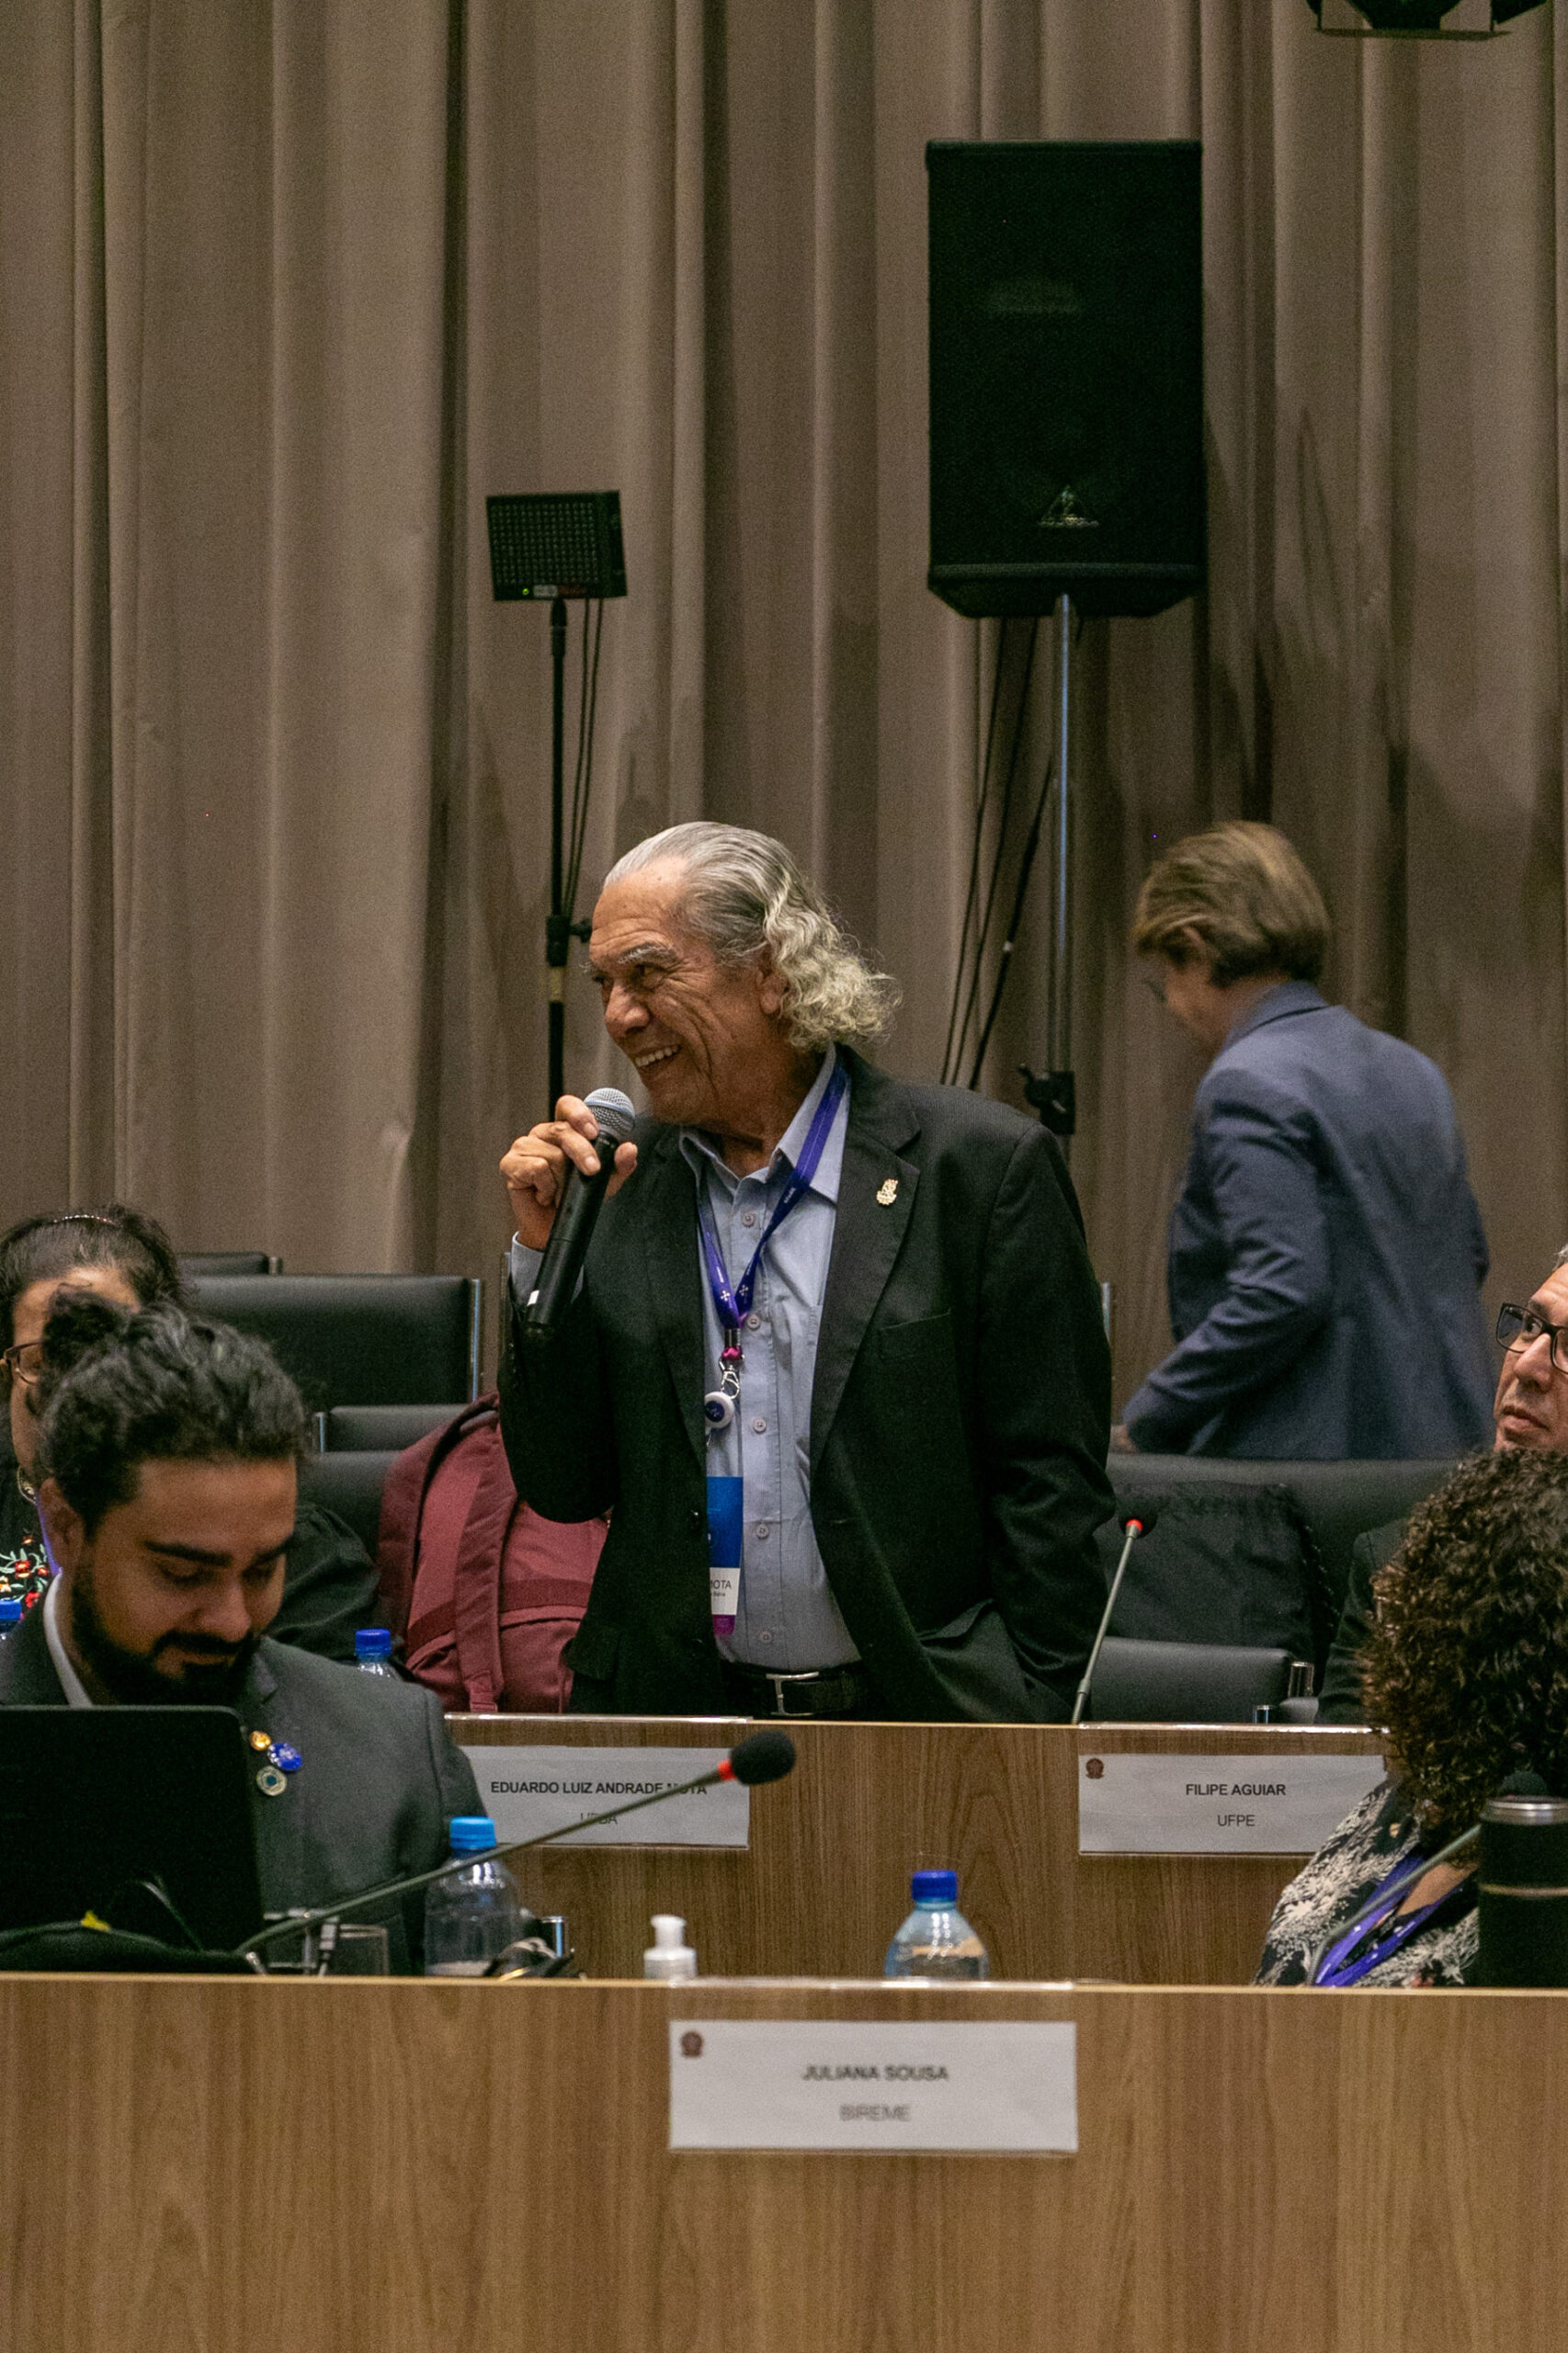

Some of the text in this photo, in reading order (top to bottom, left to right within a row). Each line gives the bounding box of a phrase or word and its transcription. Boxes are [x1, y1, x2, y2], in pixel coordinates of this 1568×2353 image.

[491, 1780, 560, 1793] EDUARDO
[562, 1781, 593, 1794] LUIZ
[596, 1781, 664, 1794] ANDRADE
[1186, 1783, 1286, 1796] FILIPE AGUIAR
[1217, 1814, 1256, 1827] UFPE
[801, 2064, 949, 2082] JULIANA SOUSA
[839, 2104, 912, 2121] BIREME
